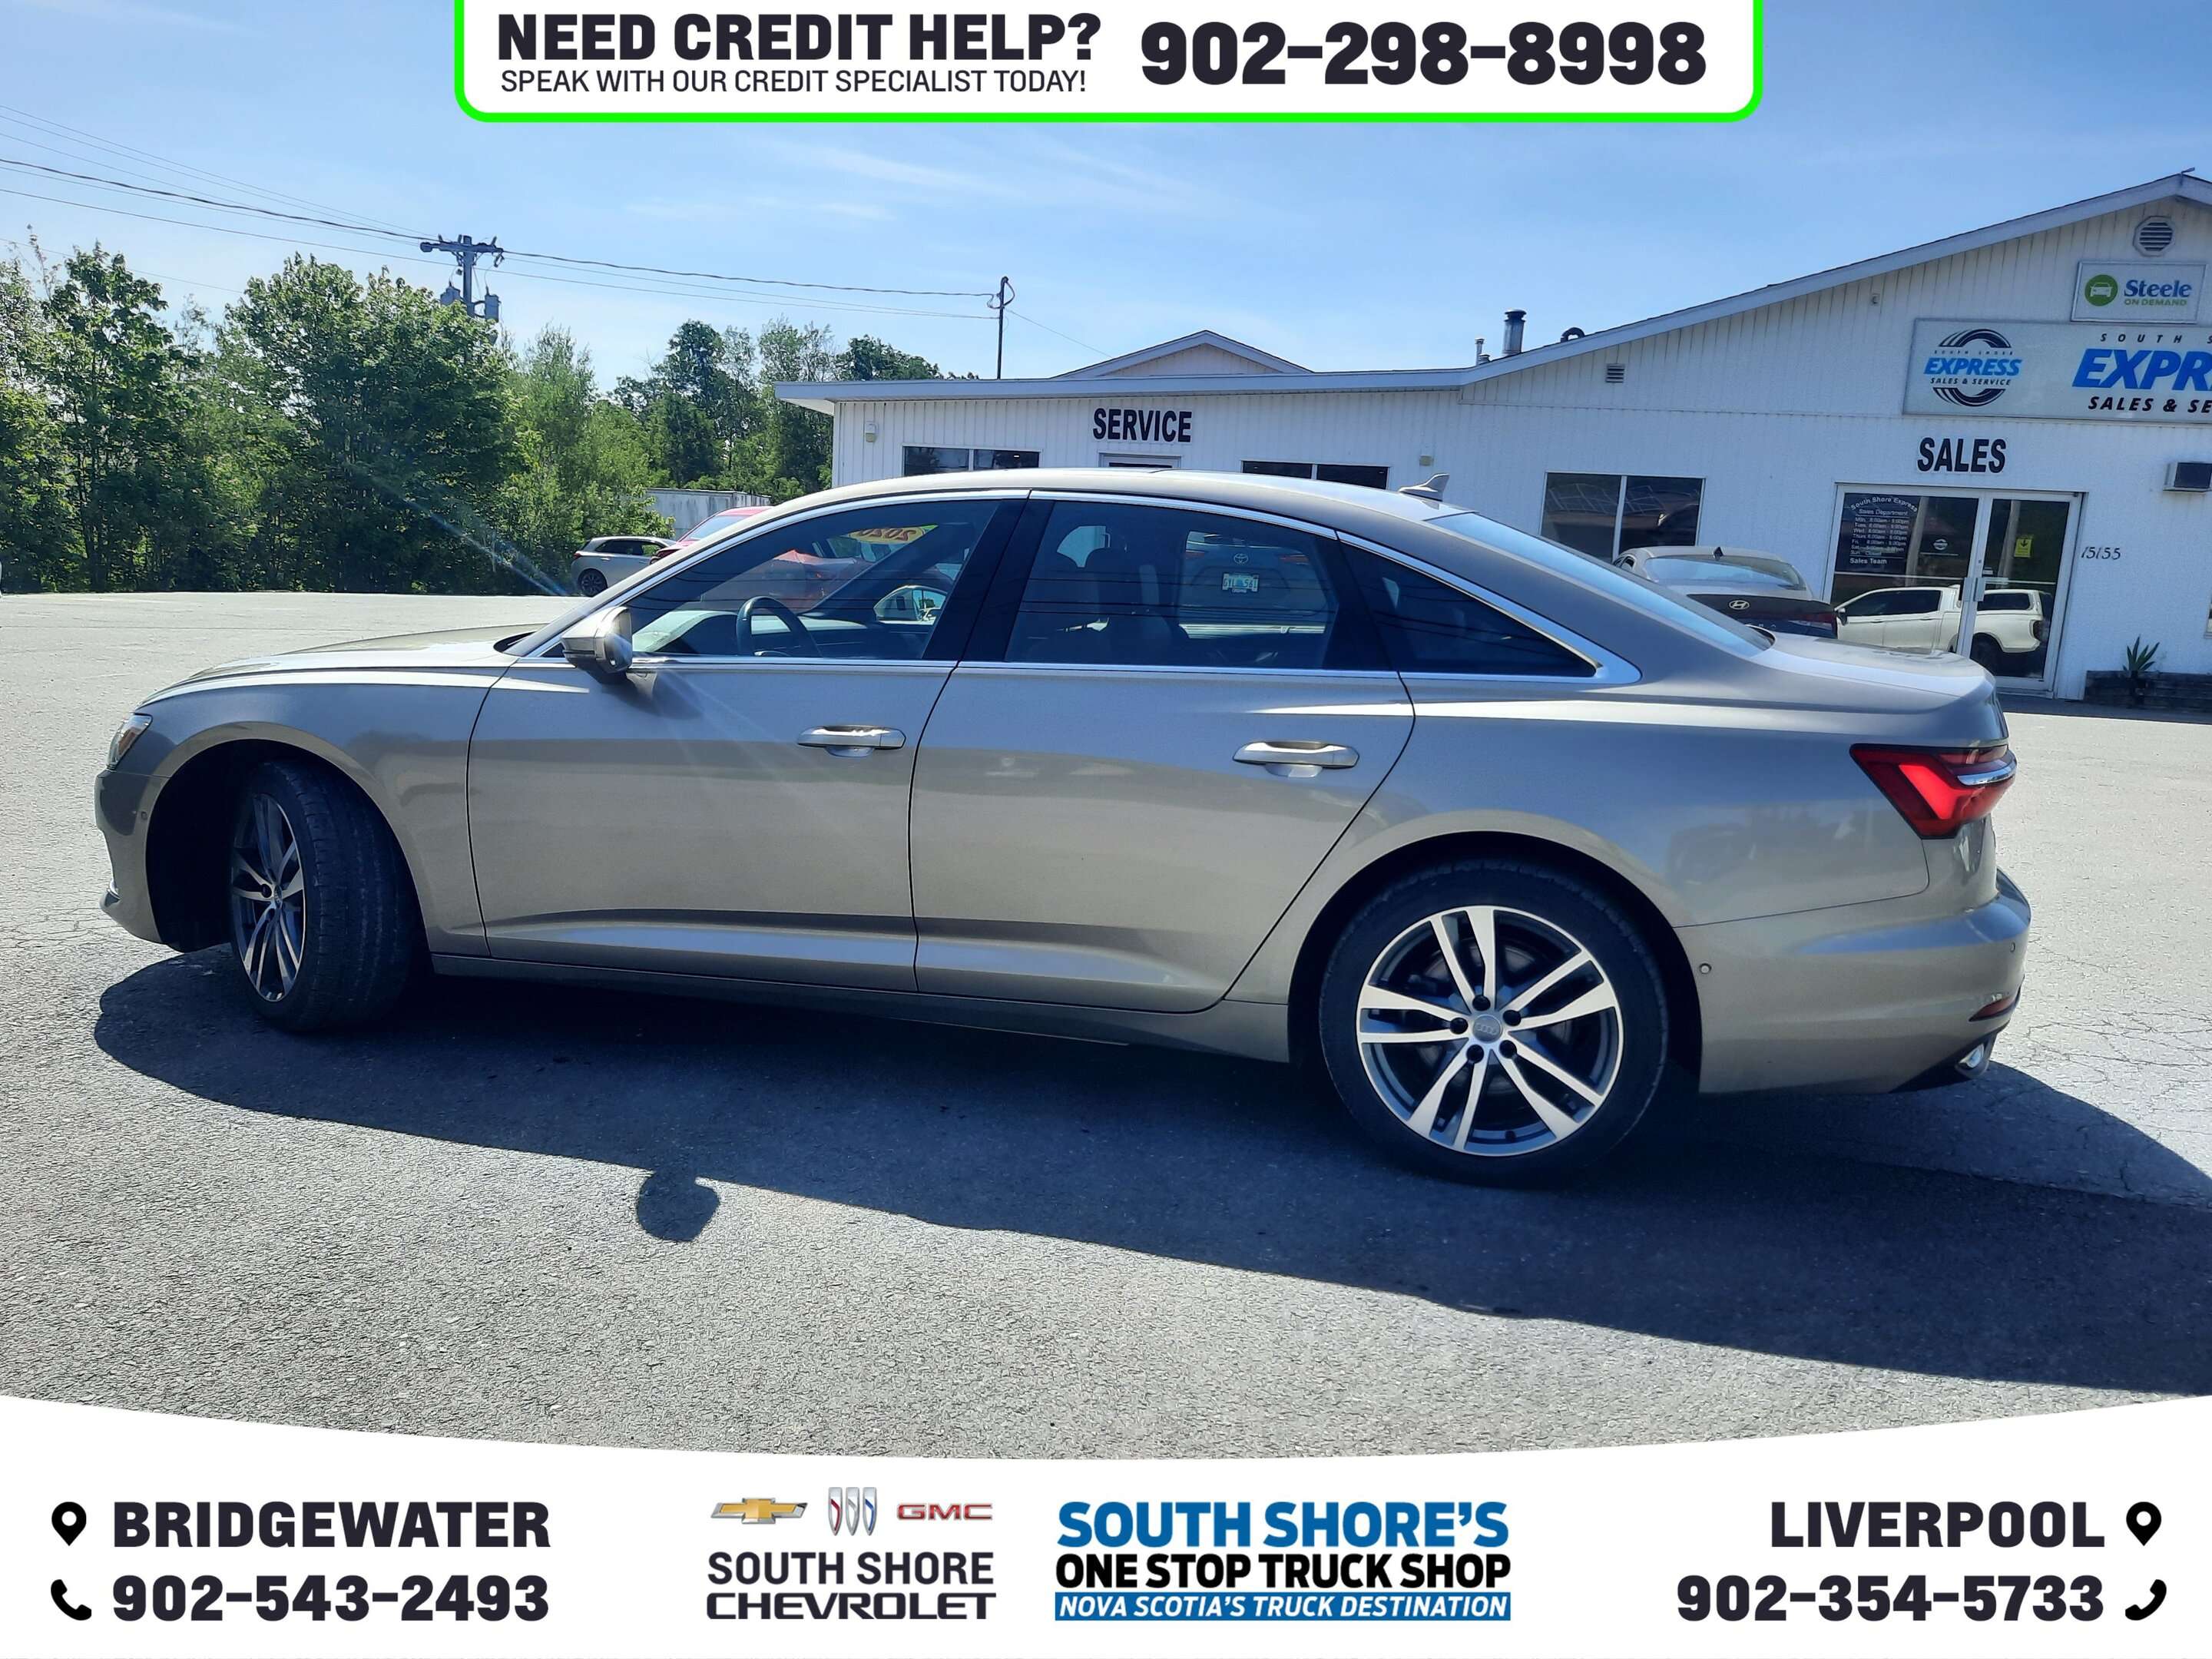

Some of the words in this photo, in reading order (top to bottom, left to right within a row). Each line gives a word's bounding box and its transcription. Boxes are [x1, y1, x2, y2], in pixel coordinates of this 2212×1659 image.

[2124, 280, 2192, 298] Steele
[2101, 333, 2182, 343] SOUTH
[1923, 357, 2022, 376] EXPRESS
[2072, 348, 2212, 391] EXPR
[2088, 396, 2154, 412] SALES
[2163, 399, 2177, 412] &
[2187, 399, 2212, 413] SE
[1093, 408, 1192, 442] SERVICE
[1917, 437, 2006, 473] SALES
[1850, 498, 1871, 511] South
[1893, 497, 1918, 512] Express
